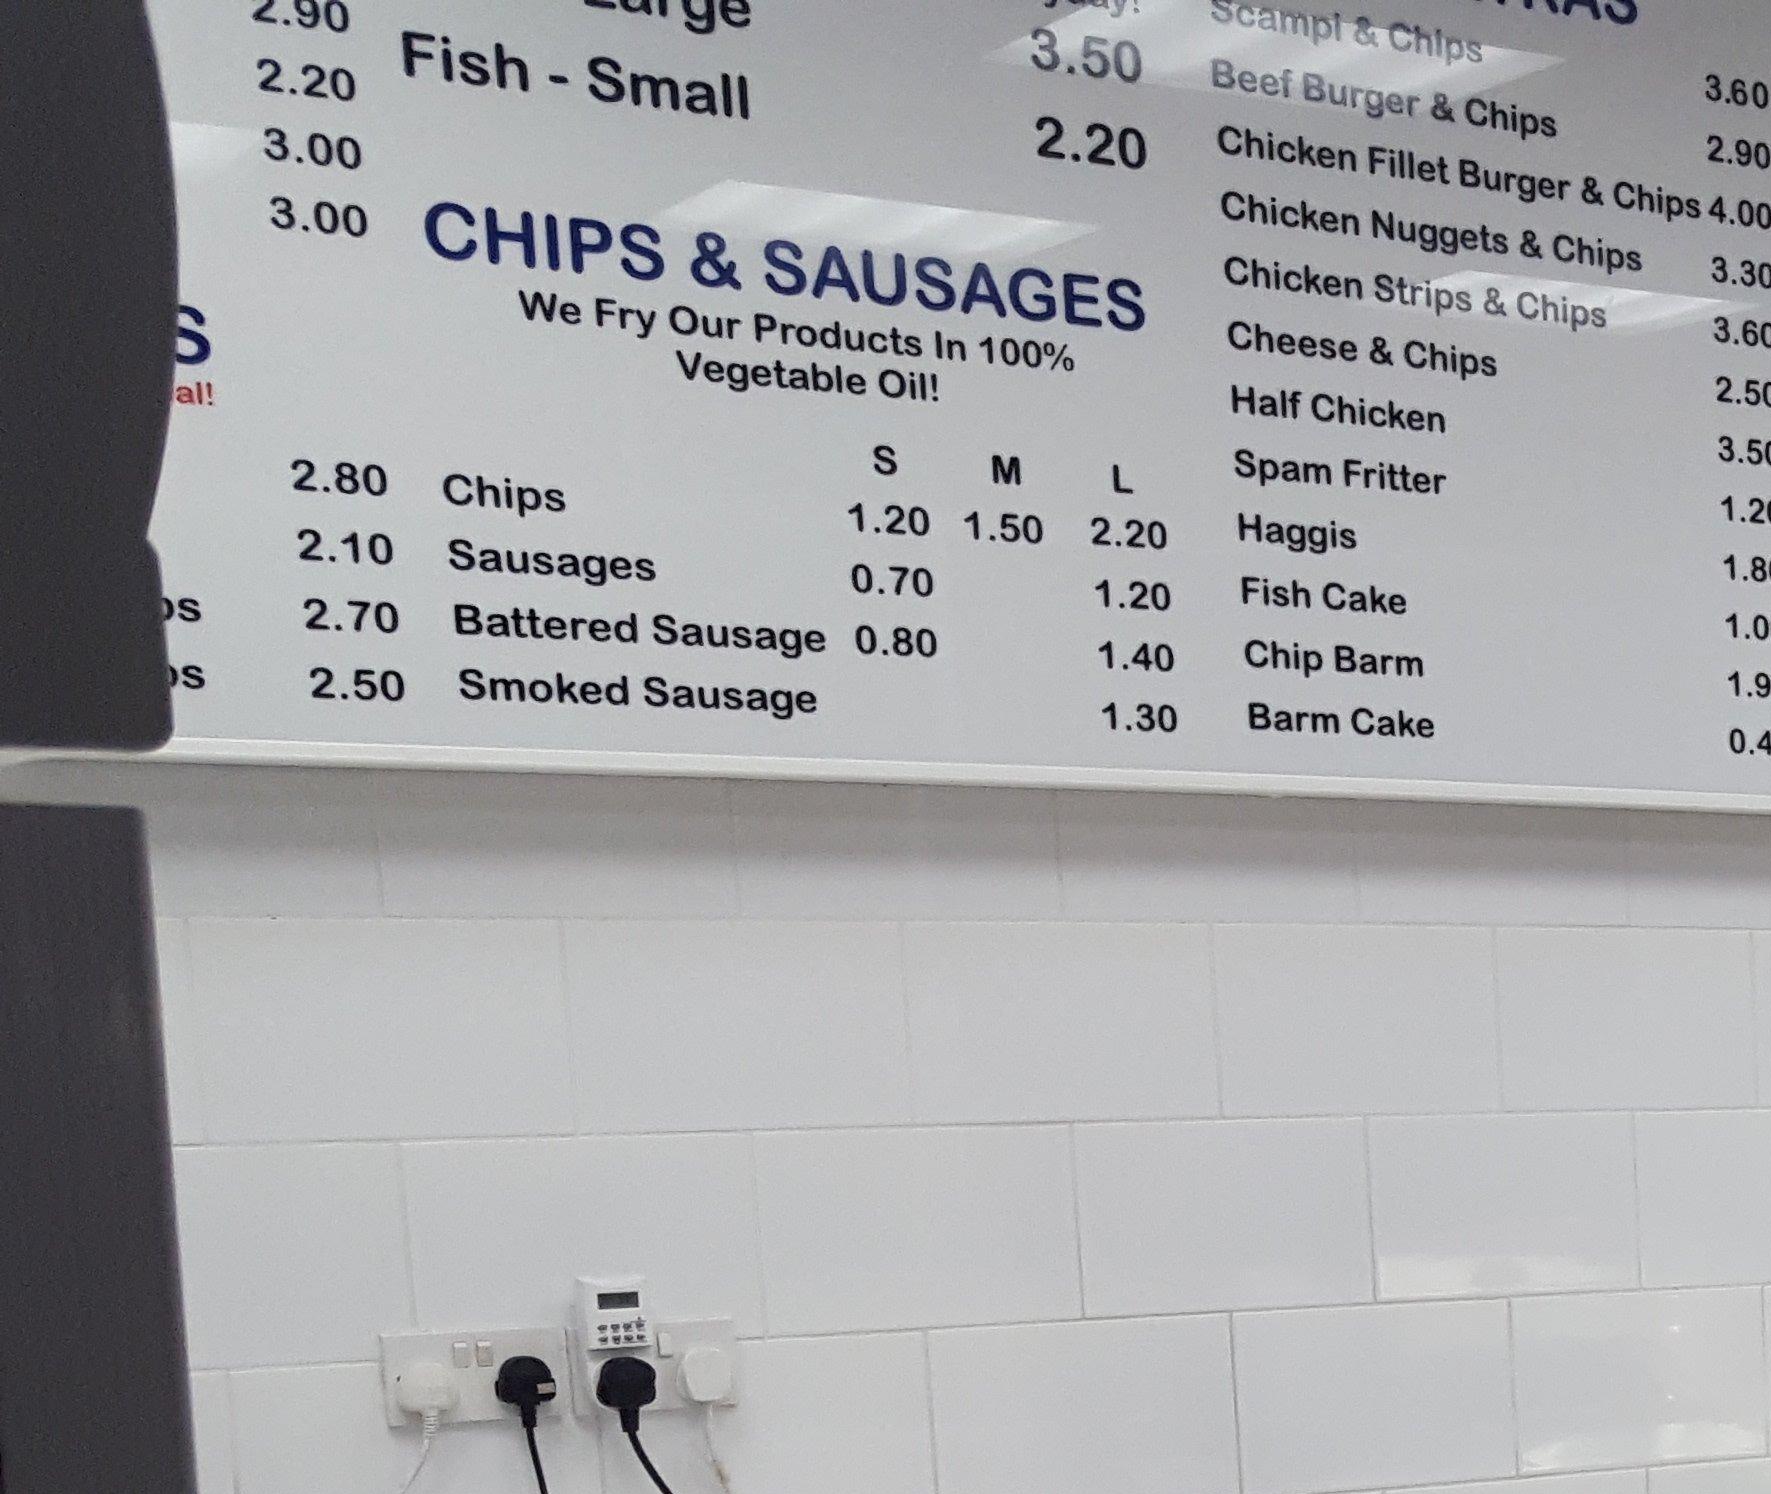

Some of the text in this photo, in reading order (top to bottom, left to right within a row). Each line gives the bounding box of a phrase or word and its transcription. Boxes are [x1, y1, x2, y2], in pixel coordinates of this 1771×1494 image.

[257, 58, 356, 101] 2.20
[1031, 26, 1142, 84] 3.50
[401, 31, 1147, 170] Fish Small 2.20
[1212, 59, 1771, 170] Beef Burger & Chips 2.90
[1705, 74, 1769, 109] 3.60
[264, 127, 362, 170] 3.00
[1217, 125, 1357, 172] Chicken
[1368, 146, 1450, 185] Fillet
[1459, 159, 1571, 203] Burger
[1581, 176, 1604, 206] &
[1613, 181, 1701, 222] Chips
[1221, 191, 1360, 236] Chicken
[1371, 210, 1509, 255] Nuggets
[1520, 230, 1543, 259] &
[1553, 234, 1643, 275] Chips
[424, 202, 1145, 331] CHIPS & SAUSAGES
[1224, 256, 1363, 300] Chicken
[1374, 274, 1472, 316] Strips
[1484, 287, 1507, 317] &
[1517, 292, 1606, 332] Chips
[518, 290, 1075, 372] We Fry Our Products In 100%
[1227, 321, 1357, 362] Cheese
[1369, 336, 1394, 366] &
[1404, 340, 1497, 381] Chips
[676, 350, 939, 402] Vegetable Oil!
[1231, 384, 1302, 419] Half
[1311, 393, 1446, 433] Chicken
[290, 459, 387, 496] 2.80
[873, 445, 1134, 494] S M L
[1234, 449, 1332, 486] Spam
[1343, 459, 1447, 494] Fritter
[442, 473, 1167, 550] Chips 1.20 1.50 2.20
[1238, 512, 1357, 554] Haggis
[448, 539, 1171, 611] Sausages 0.70 1.20
[1241, 576, 1311, 609] Fish
[1322, 582, 1407, 615] Cake
[454, 604, 1174, 672] Battered Sausage 0.80 1.40
[1244, 639, 1323, 678] Chip
[1334, 645, 1424, 677] Barm
[309, 667, 405, 702] 2.50
[459, 668, 1178, 733] Smoked Sausage 1.30
[1248, 702, 1340, 734] Barm
[1351, 707, 1434, 738] Cake
